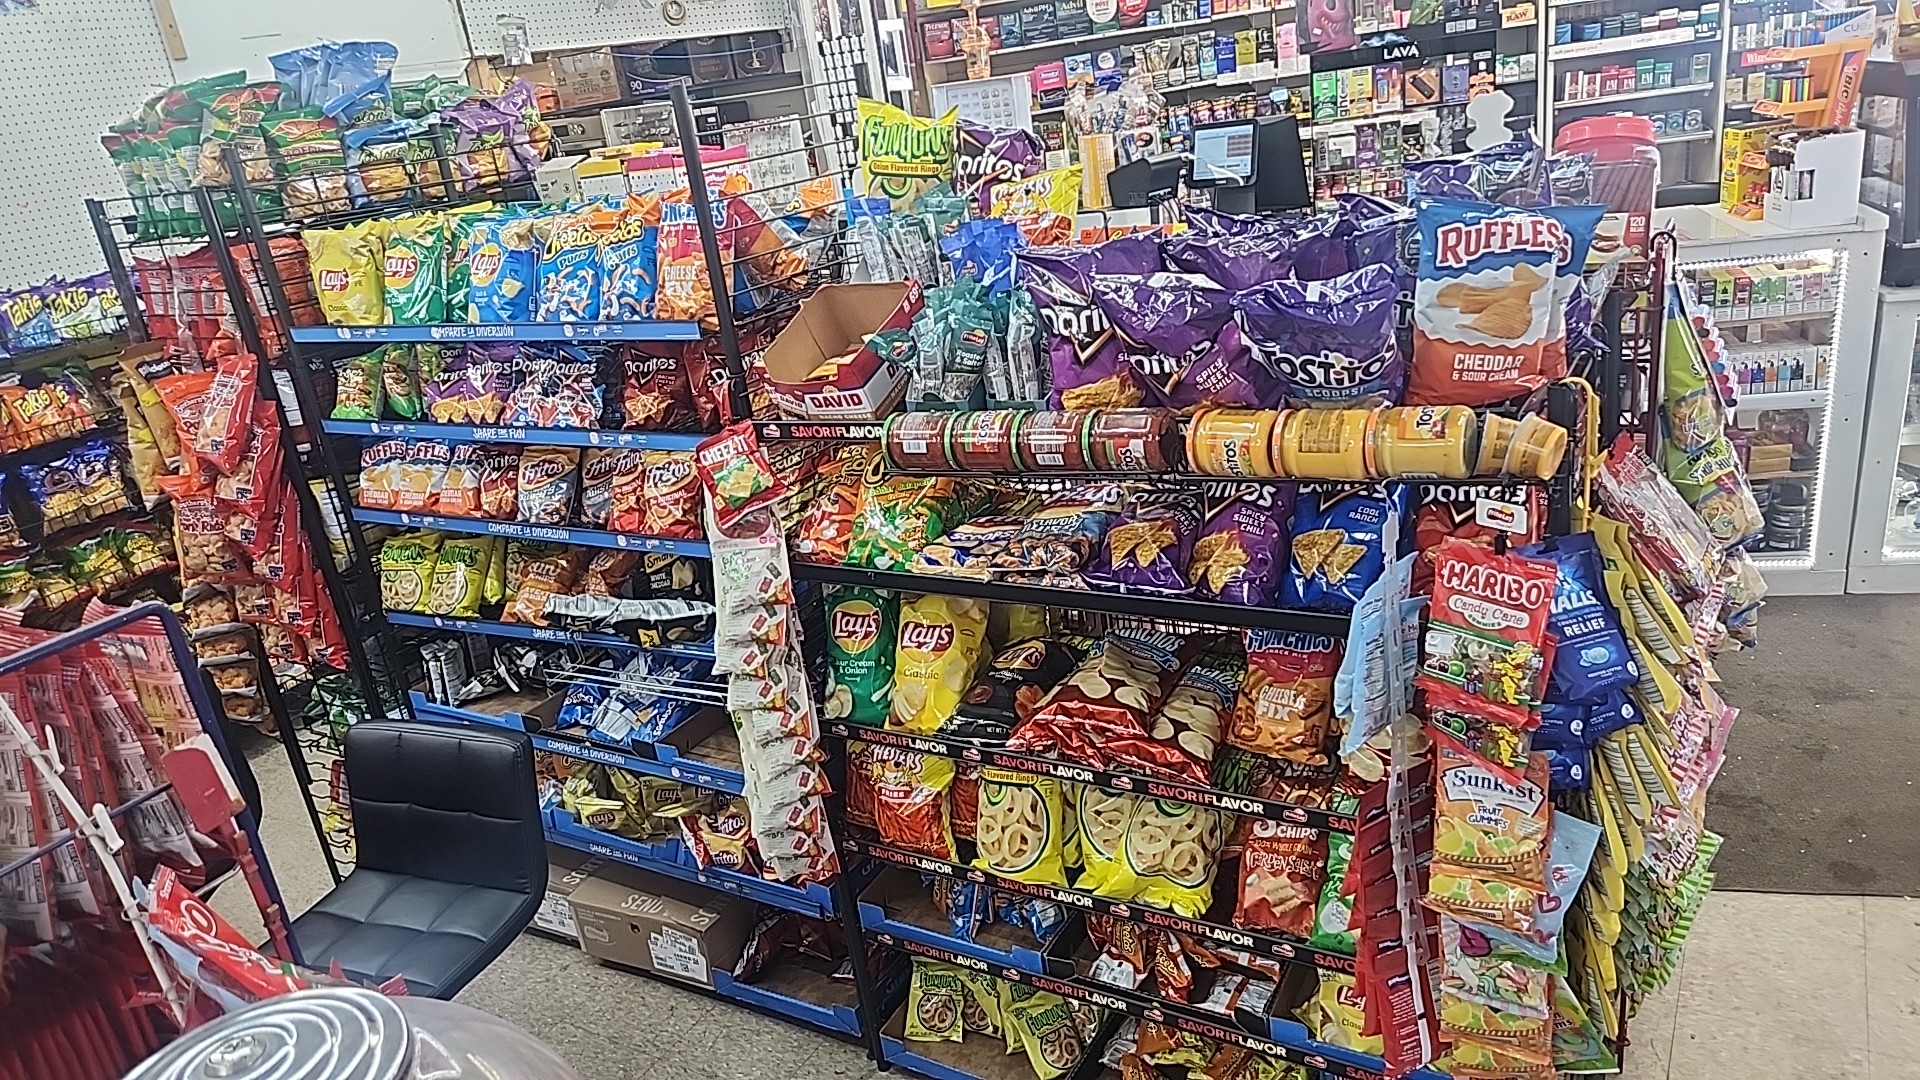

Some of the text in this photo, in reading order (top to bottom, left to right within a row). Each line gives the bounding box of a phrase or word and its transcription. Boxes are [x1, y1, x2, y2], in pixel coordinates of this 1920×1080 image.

[1506, 11, 1529, 23] RAW
[1383, 45, 1420, 59] LAVA
[630, 80, 642, 91] 90
[873, 163, 940, 174] Onion Flavored Rings
[956, 150, 1025, 182] oritos
[1629, 216, 1646, 226] 120
[1436, 216, 1564, 268] RUFFLES
[472, 254, 500, 276] Lay's
[665, 266, 697, 281] CHEESE
[321, 269, 348, 291] Lay's
[666, 282, 693, 297] FIX
[2, 294, 43, 330] Takis
[46, 286, 90, 323] Takis
[476, 325, 514, 338] DIVERSIÓN
[624, 358, 678, 377] Doritos
[1196, 357, 1223, 384] SPICY
[1258, 345, 1388, 386] TOSTITO
[1454, 353, 1524, 370] CHEDDAR
[1196, 363, 1230, 391] SWEET
[1210, 372, 1235, 393] CHILI
[1452, 369, 1519, 380] & SOUR CREAM
[13, 387, 51, 423] Takis
[808, 392, 864, 409] DAVID
[472, 428, 497, 438] SHARE
[509, 428, 525, 438] FUN
[522, 459, 563, 482] Fritos
[1232, 513, 1265, 528] SWEET
[1240, 507, 1267, 522] SPICY
[1348, 511, 1379, 523] RANCH
[1357, 506, 1380, 516] COOL
[488, 523, 523, 535] COMPARTE
[532, 527, 570, 541] DIVERSIÓN
[1240, 523, 1265, 536] CHILI
[1442, 559, 1548, 610] HARIBO
[1453, 596, 1524, 627] Candy Cane
[834, 611, 880, 641] Lay's
[1563, 618, 1606, 638] RELIEF
[901, 622, 952, 652] Lay's
[845, 667, 868, 675] Onion
[849, 659, 875, 668] Cream
[1257, 703, 1290, 721] FIX
[902, 736, 948, 754] FLAVOR
[1042, 762, 1094, 782] FLAVOR
[1452, 769, 1537, 804] Sunkst
[1204, 794, 1265, 815] FLAVOR
[1478, 806, 1502, 816] FRUIT
[1276, 826, 1318, 840] CHIPS
[1328, 816, 1358, 831] SAV
[909, 854, 953, 875] FLAVOR
[620, 893, 665, 916] SEND
[1044, 889, 1093, 908] FLAVOR
[1198, 926, 1254, 948] FLAVOR
[943, 952, 989, 972] FLAVOR
[1077, 989, 1128, 1012] FLAVOR
[1337, 987, 1366, 1011] Lay
[1341, 1018, 1362, 1031] Class
[1231, 1034, 1287, 1057] FLAVOR
